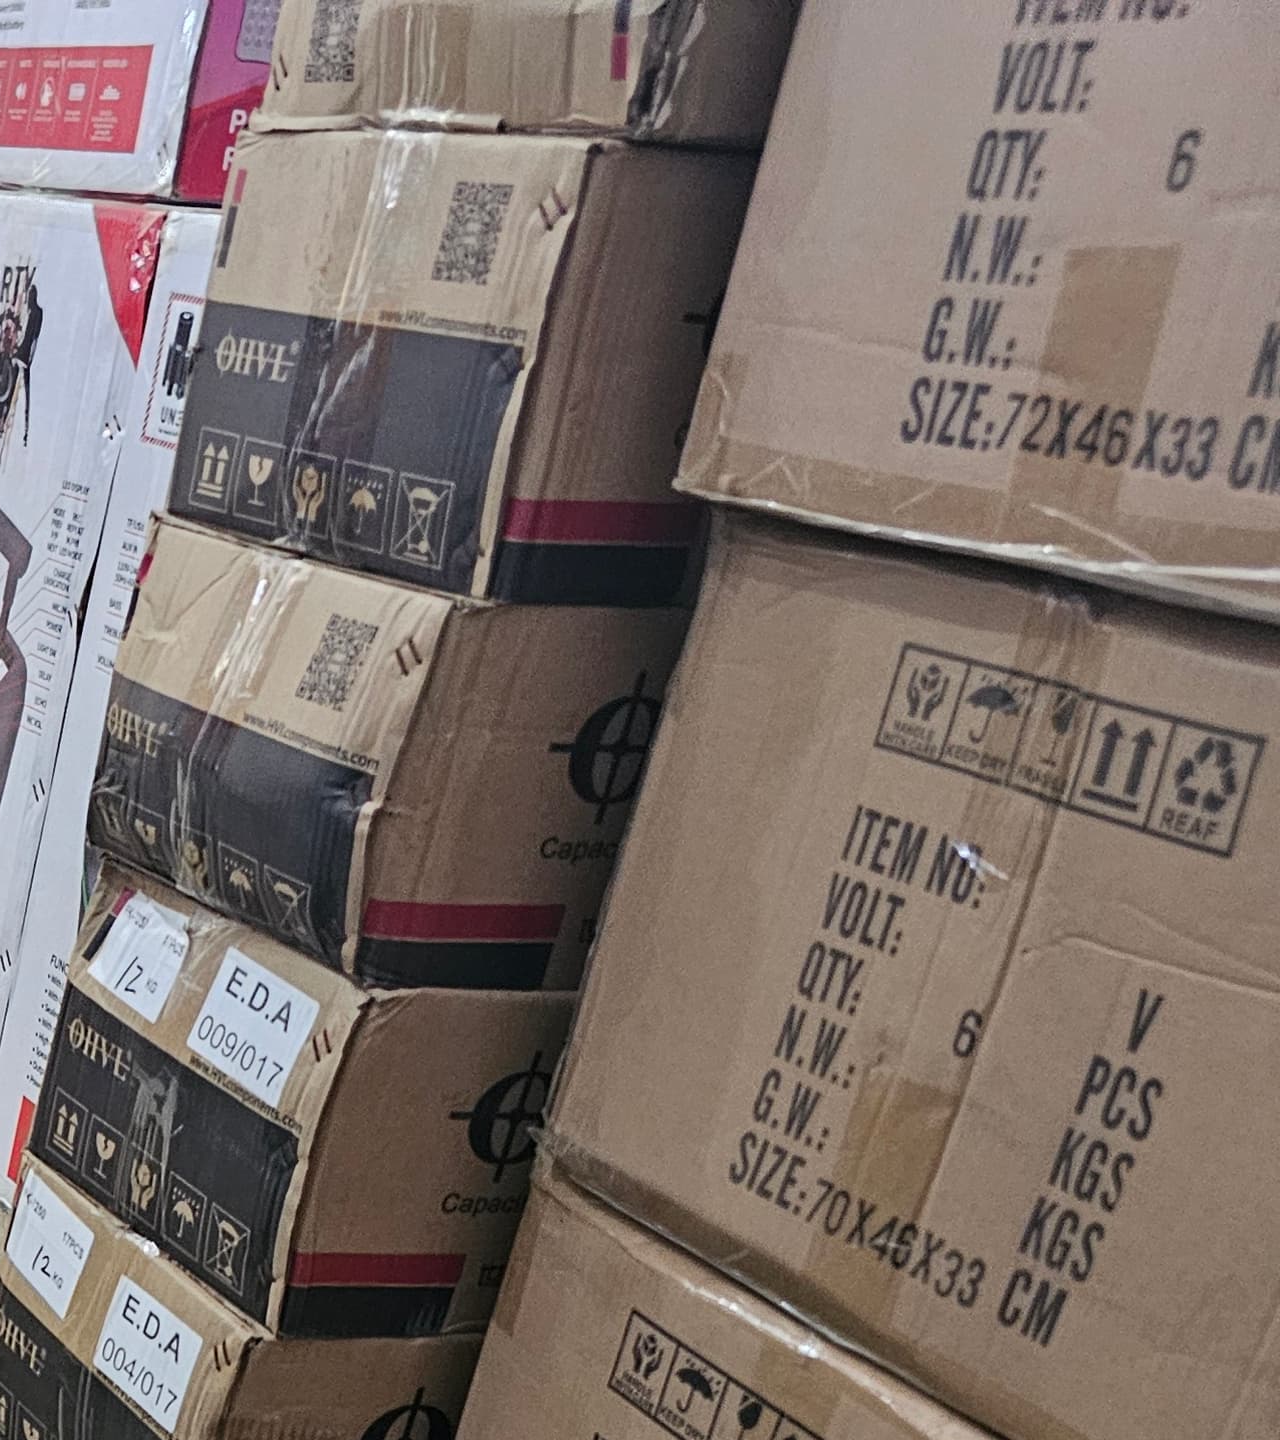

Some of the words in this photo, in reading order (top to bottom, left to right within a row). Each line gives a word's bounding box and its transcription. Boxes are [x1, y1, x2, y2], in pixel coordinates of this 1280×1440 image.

[992, 39, 1097, 115] VOLT:
[966, 128, 1048, 202] QTY:
[1165, 128, 1202, 193] 6
[842, 805, 933, 884] ITEM
[819, 870, 904, 957] VOLT:
[225, 966, 293, 1034] E.D.A
[797, 940, 862, 1017] QTY:
[952, 1008, 982, 1058] 6
[1126, 987, 1165, 1056] V
[197, 1015, 284, 1089] 009/017
[1074, 1055, 1164, 1142] PCS
[1048, 1128, 1136, 1214] KGS
[1018, 1195, 1106, 1283] KGS
[121, 1293, 181, 1364] E.D.A
[996, 1269, 1069, 1350] CM
[101, 1337, 178, 1414] 004/017
